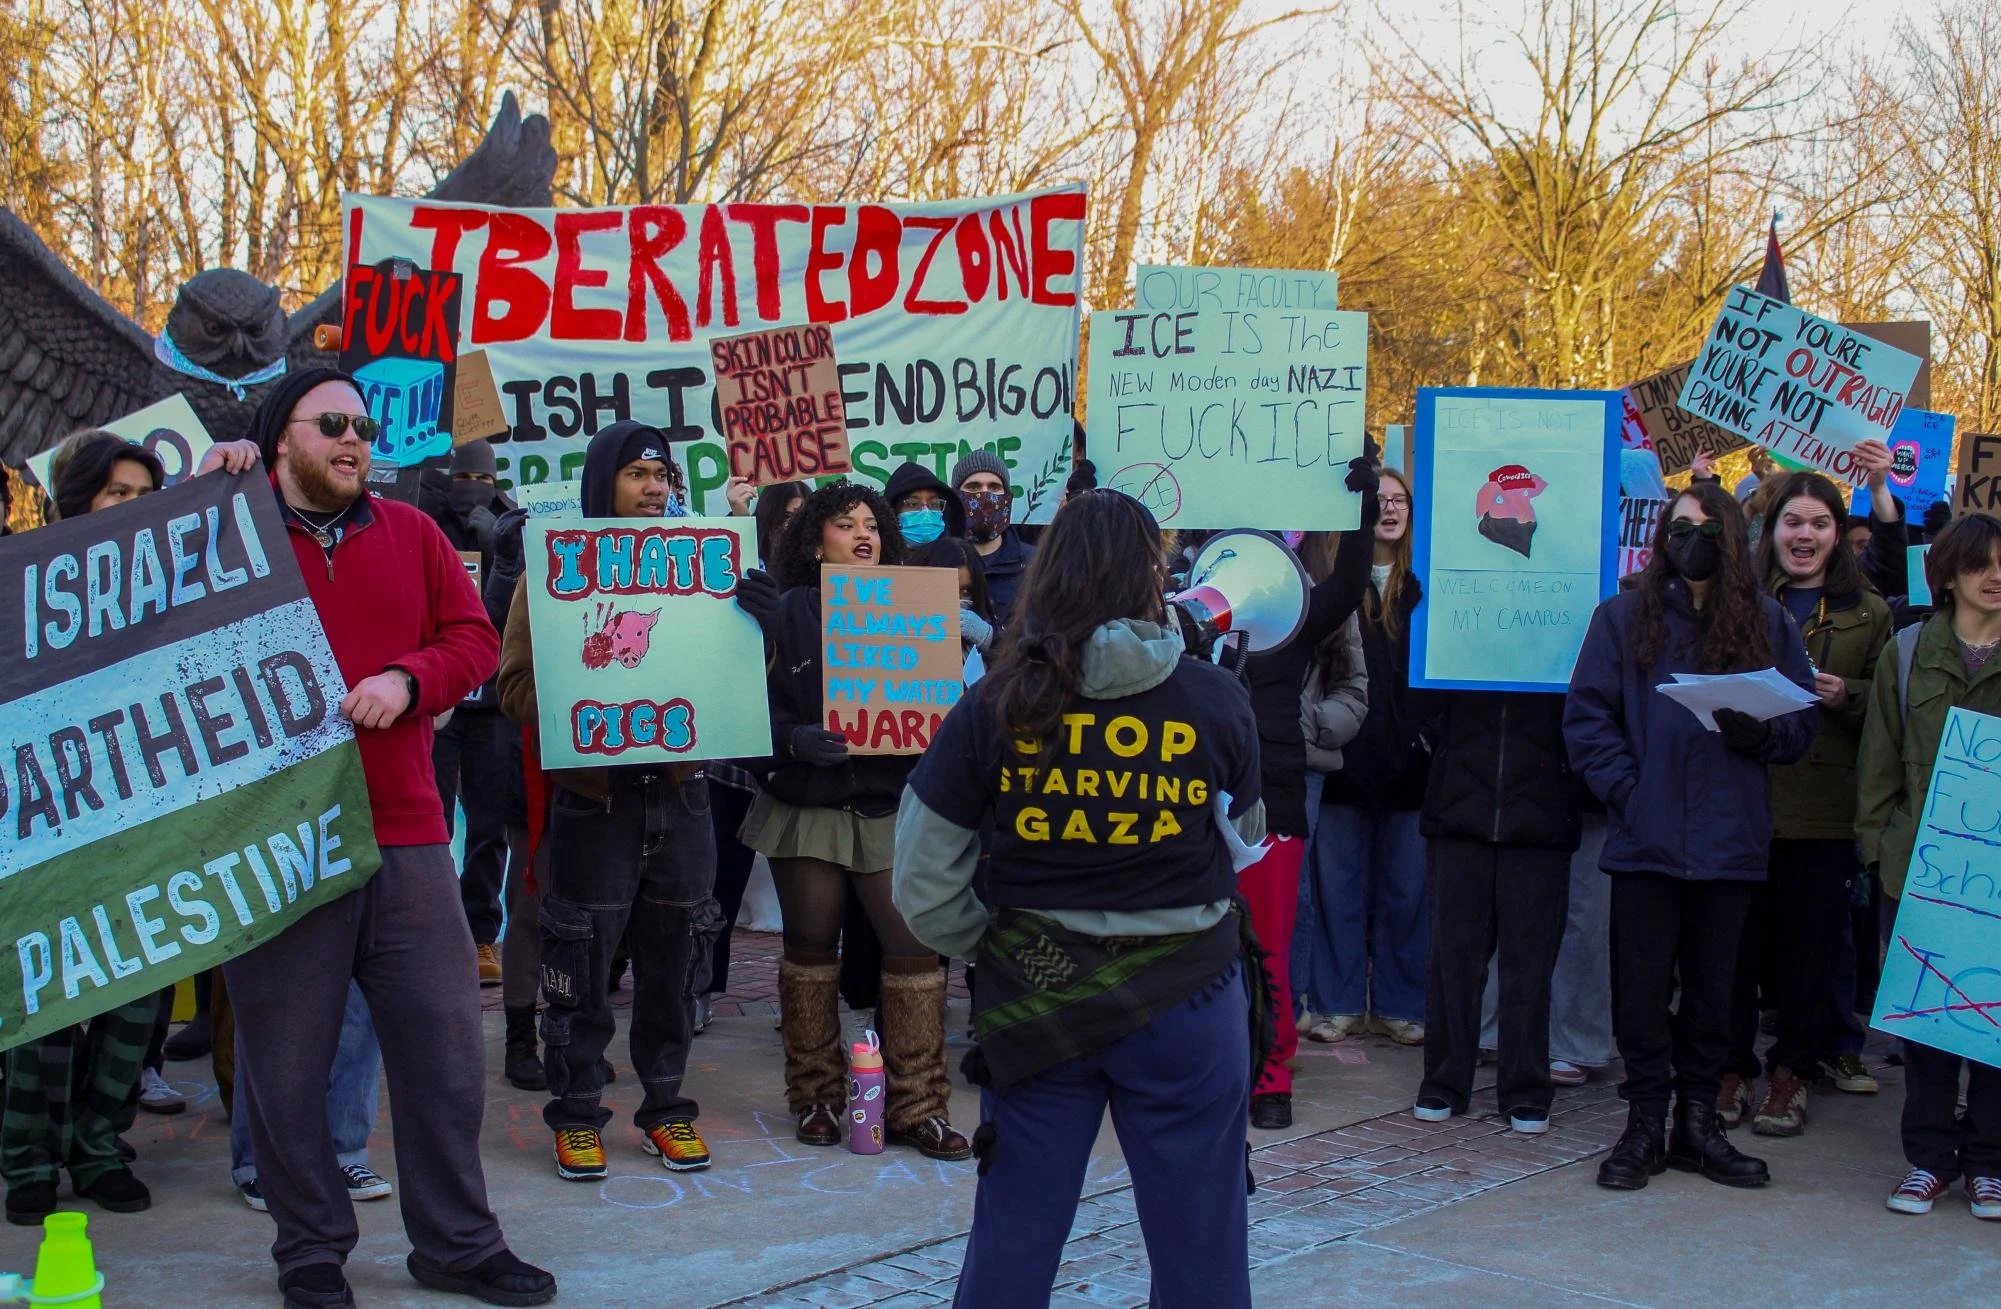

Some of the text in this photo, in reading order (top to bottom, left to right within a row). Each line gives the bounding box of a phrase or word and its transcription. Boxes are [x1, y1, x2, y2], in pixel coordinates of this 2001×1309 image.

[903, 193, 1087, 314] ZONE
[1143, 271, 1325, 309] OUR FACULTY
[1727, 289, 1782, 322] IF
[340, 266, 457, 364] FUCK
[1113, 312, 1199, 358] ICE
[1220, 312, 1263, 354] IS
[712, 327, 833, 374] SKIN COLOR
[1717, 317, 1902, 430] NOT OUTRAGED
[732, 362, 817, 405] ISN'T
[837, 359, 946, 429] END
[953, 357, 1027, 423] BIG
[1109, 371, 1153, 397] NEW
[1250, 368, 1280, 392] day
[1288, 364, 1362, 394] NAZI
[1631, 362, 1694, 413] IMMI
[724, 391, 842, 441] PROBABLE
[1440, 408, 1576, 432] ICE IS NOT
[1687, 381, 1757, 433] PAYING
[1770, 381, 1833, 434] NOT
[730, 426, 848, 482] CAUSE
[1117, 398, 1356, 468] FUCK ICE
[528, 498, 577, 513] NOBODY'S
[24, 492, 271, 660] ISRAELI
[553, 534, 736, 592] I HATE
[1551, 580, 1572, 594] ON
[826, 611, 949, 642] ALWAYS
[1453, 606, 1482, 631] MY
[827, 643, 920, 671] LIKED
[827, 678, 963, 705] MY WATER
[578, 704, 690, 748] PIGS
[1000, 766, 1208, 805] STARVING
[1016, 806, 1183, 845] GAZA
[16, 802, 352, 1016] PALESTINE
